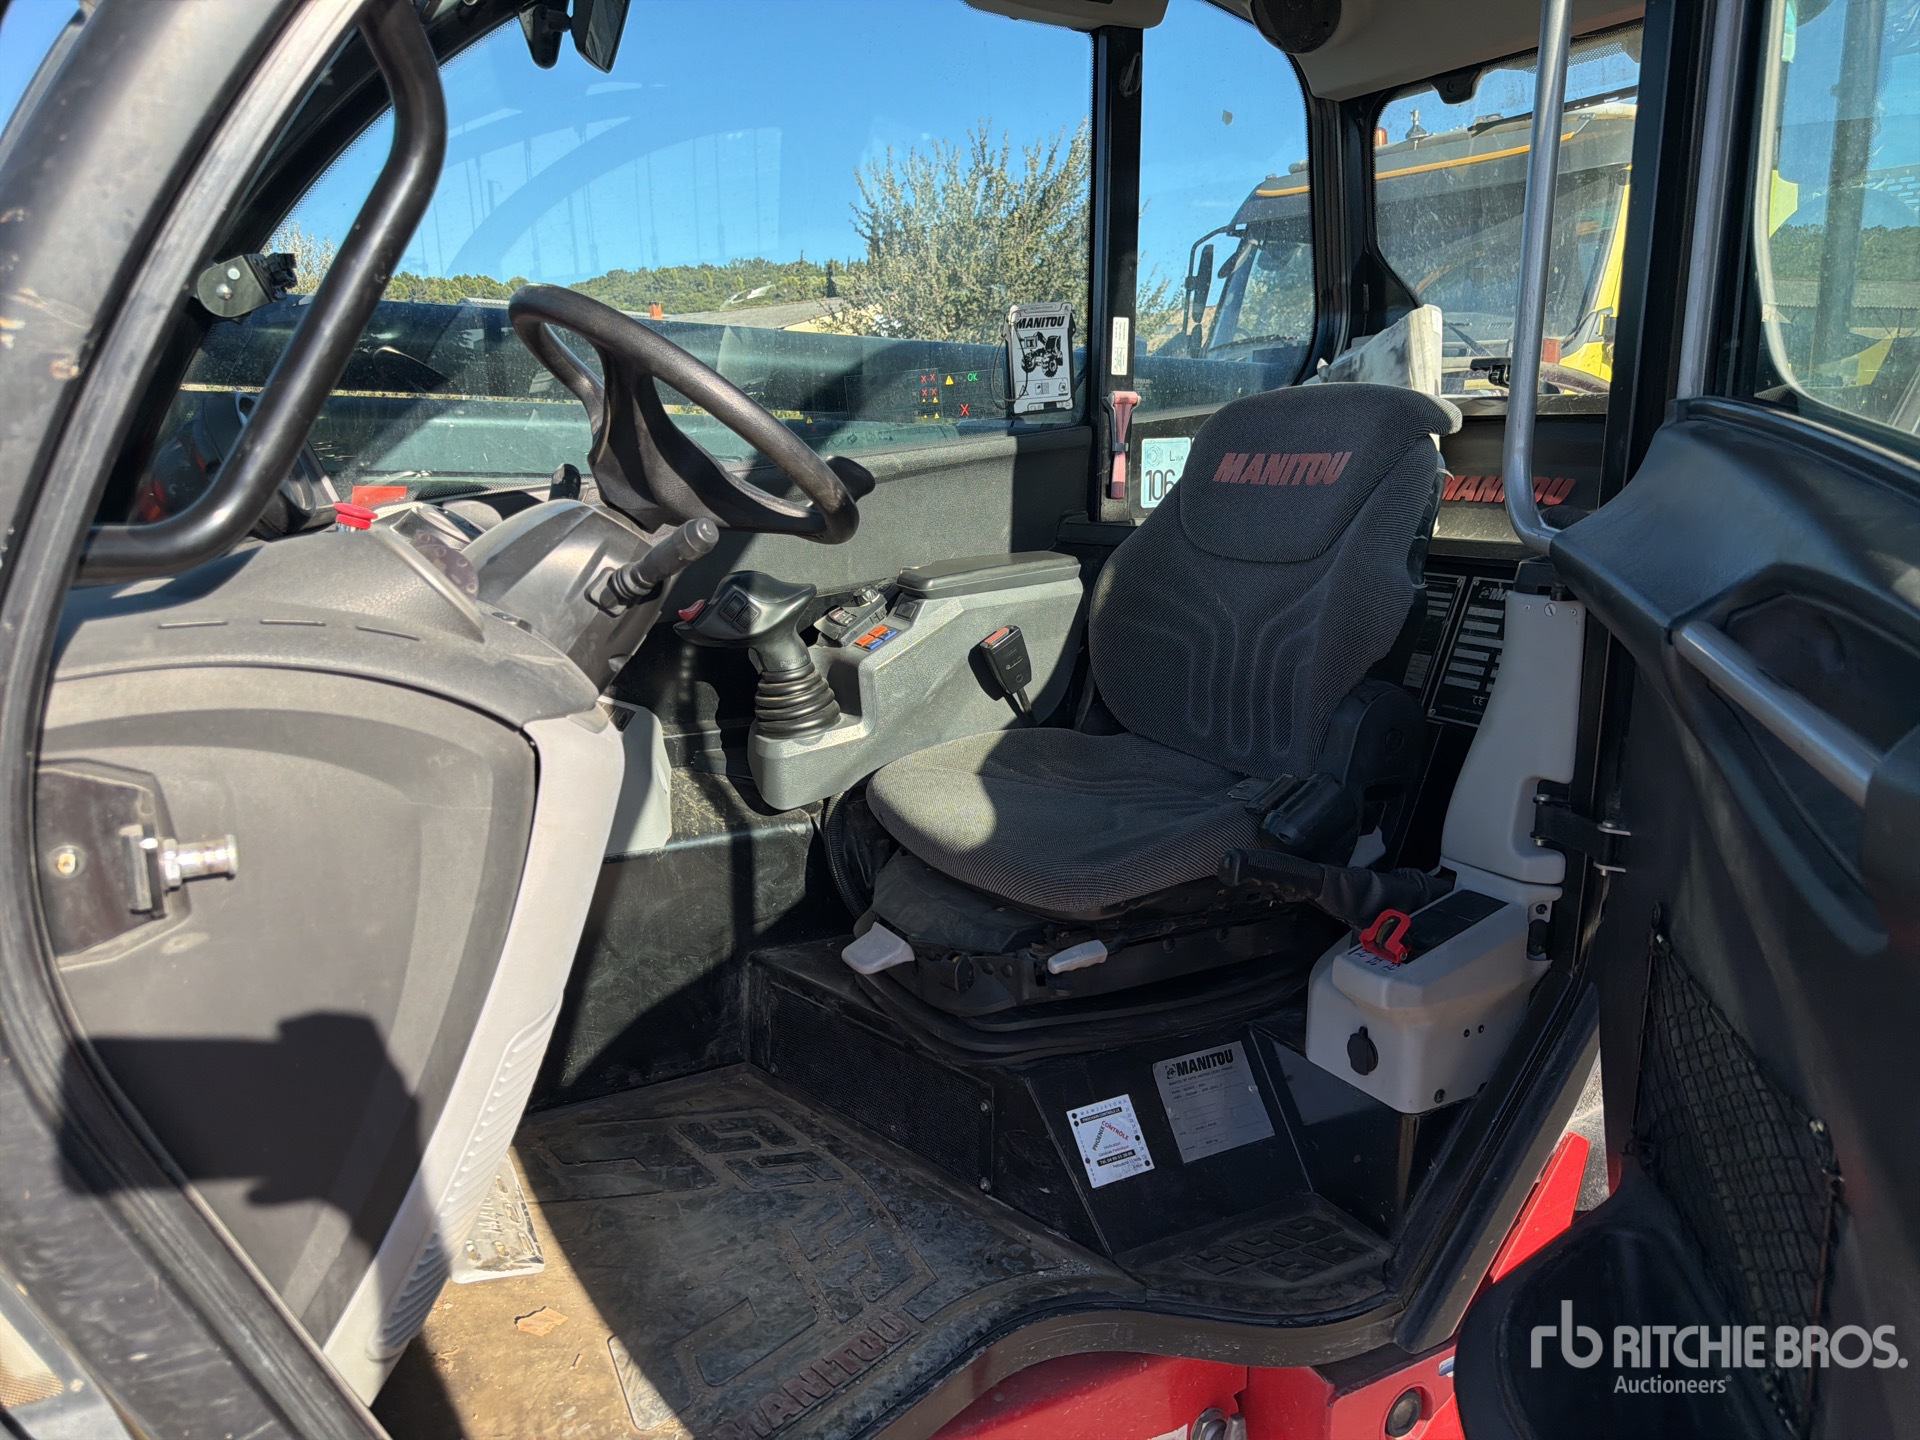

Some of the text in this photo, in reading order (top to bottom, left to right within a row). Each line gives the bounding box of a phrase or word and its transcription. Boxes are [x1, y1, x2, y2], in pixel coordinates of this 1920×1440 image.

[1016, 315, 1065, 330] MANITOU
[967, 372, 978, 382] OK
[1212, 451, 1353, 487] MANITOU
[1145, 468, 1176, 502] 106
[1176, 1049, 1234, 1077] MANITOU
